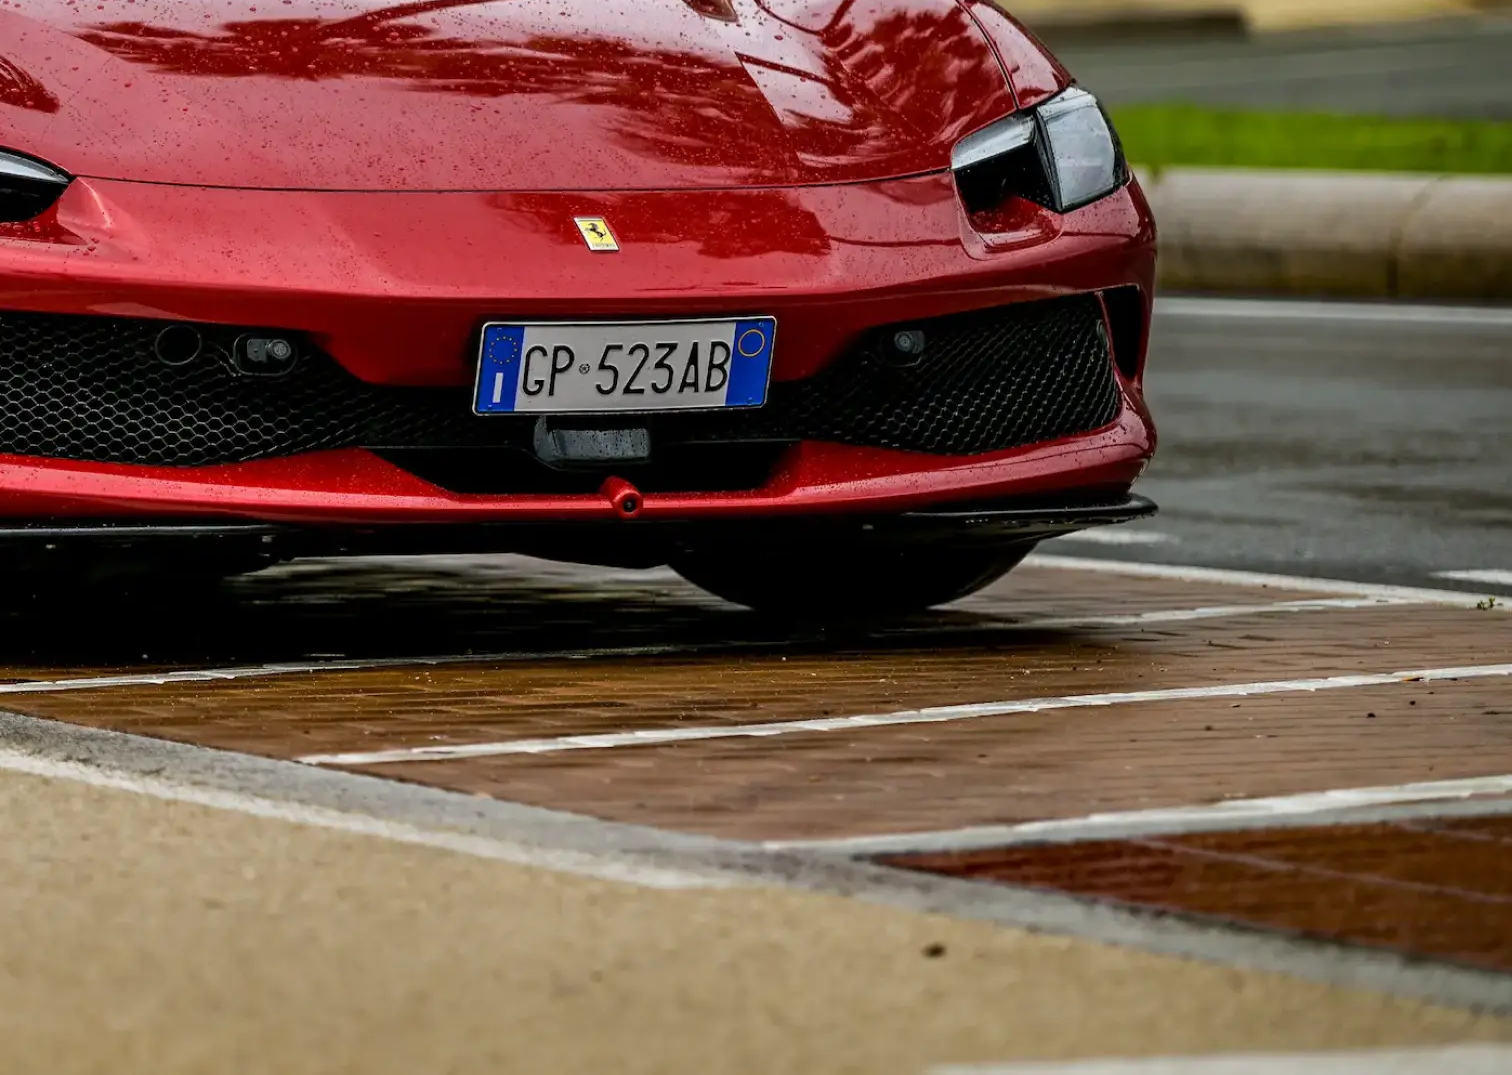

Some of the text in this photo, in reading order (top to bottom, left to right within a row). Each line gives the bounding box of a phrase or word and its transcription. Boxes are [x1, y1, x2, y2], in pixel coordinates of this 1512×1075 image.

[492, 372, 504, 403] I
[522, 340, 731, 396] GP 523AB
